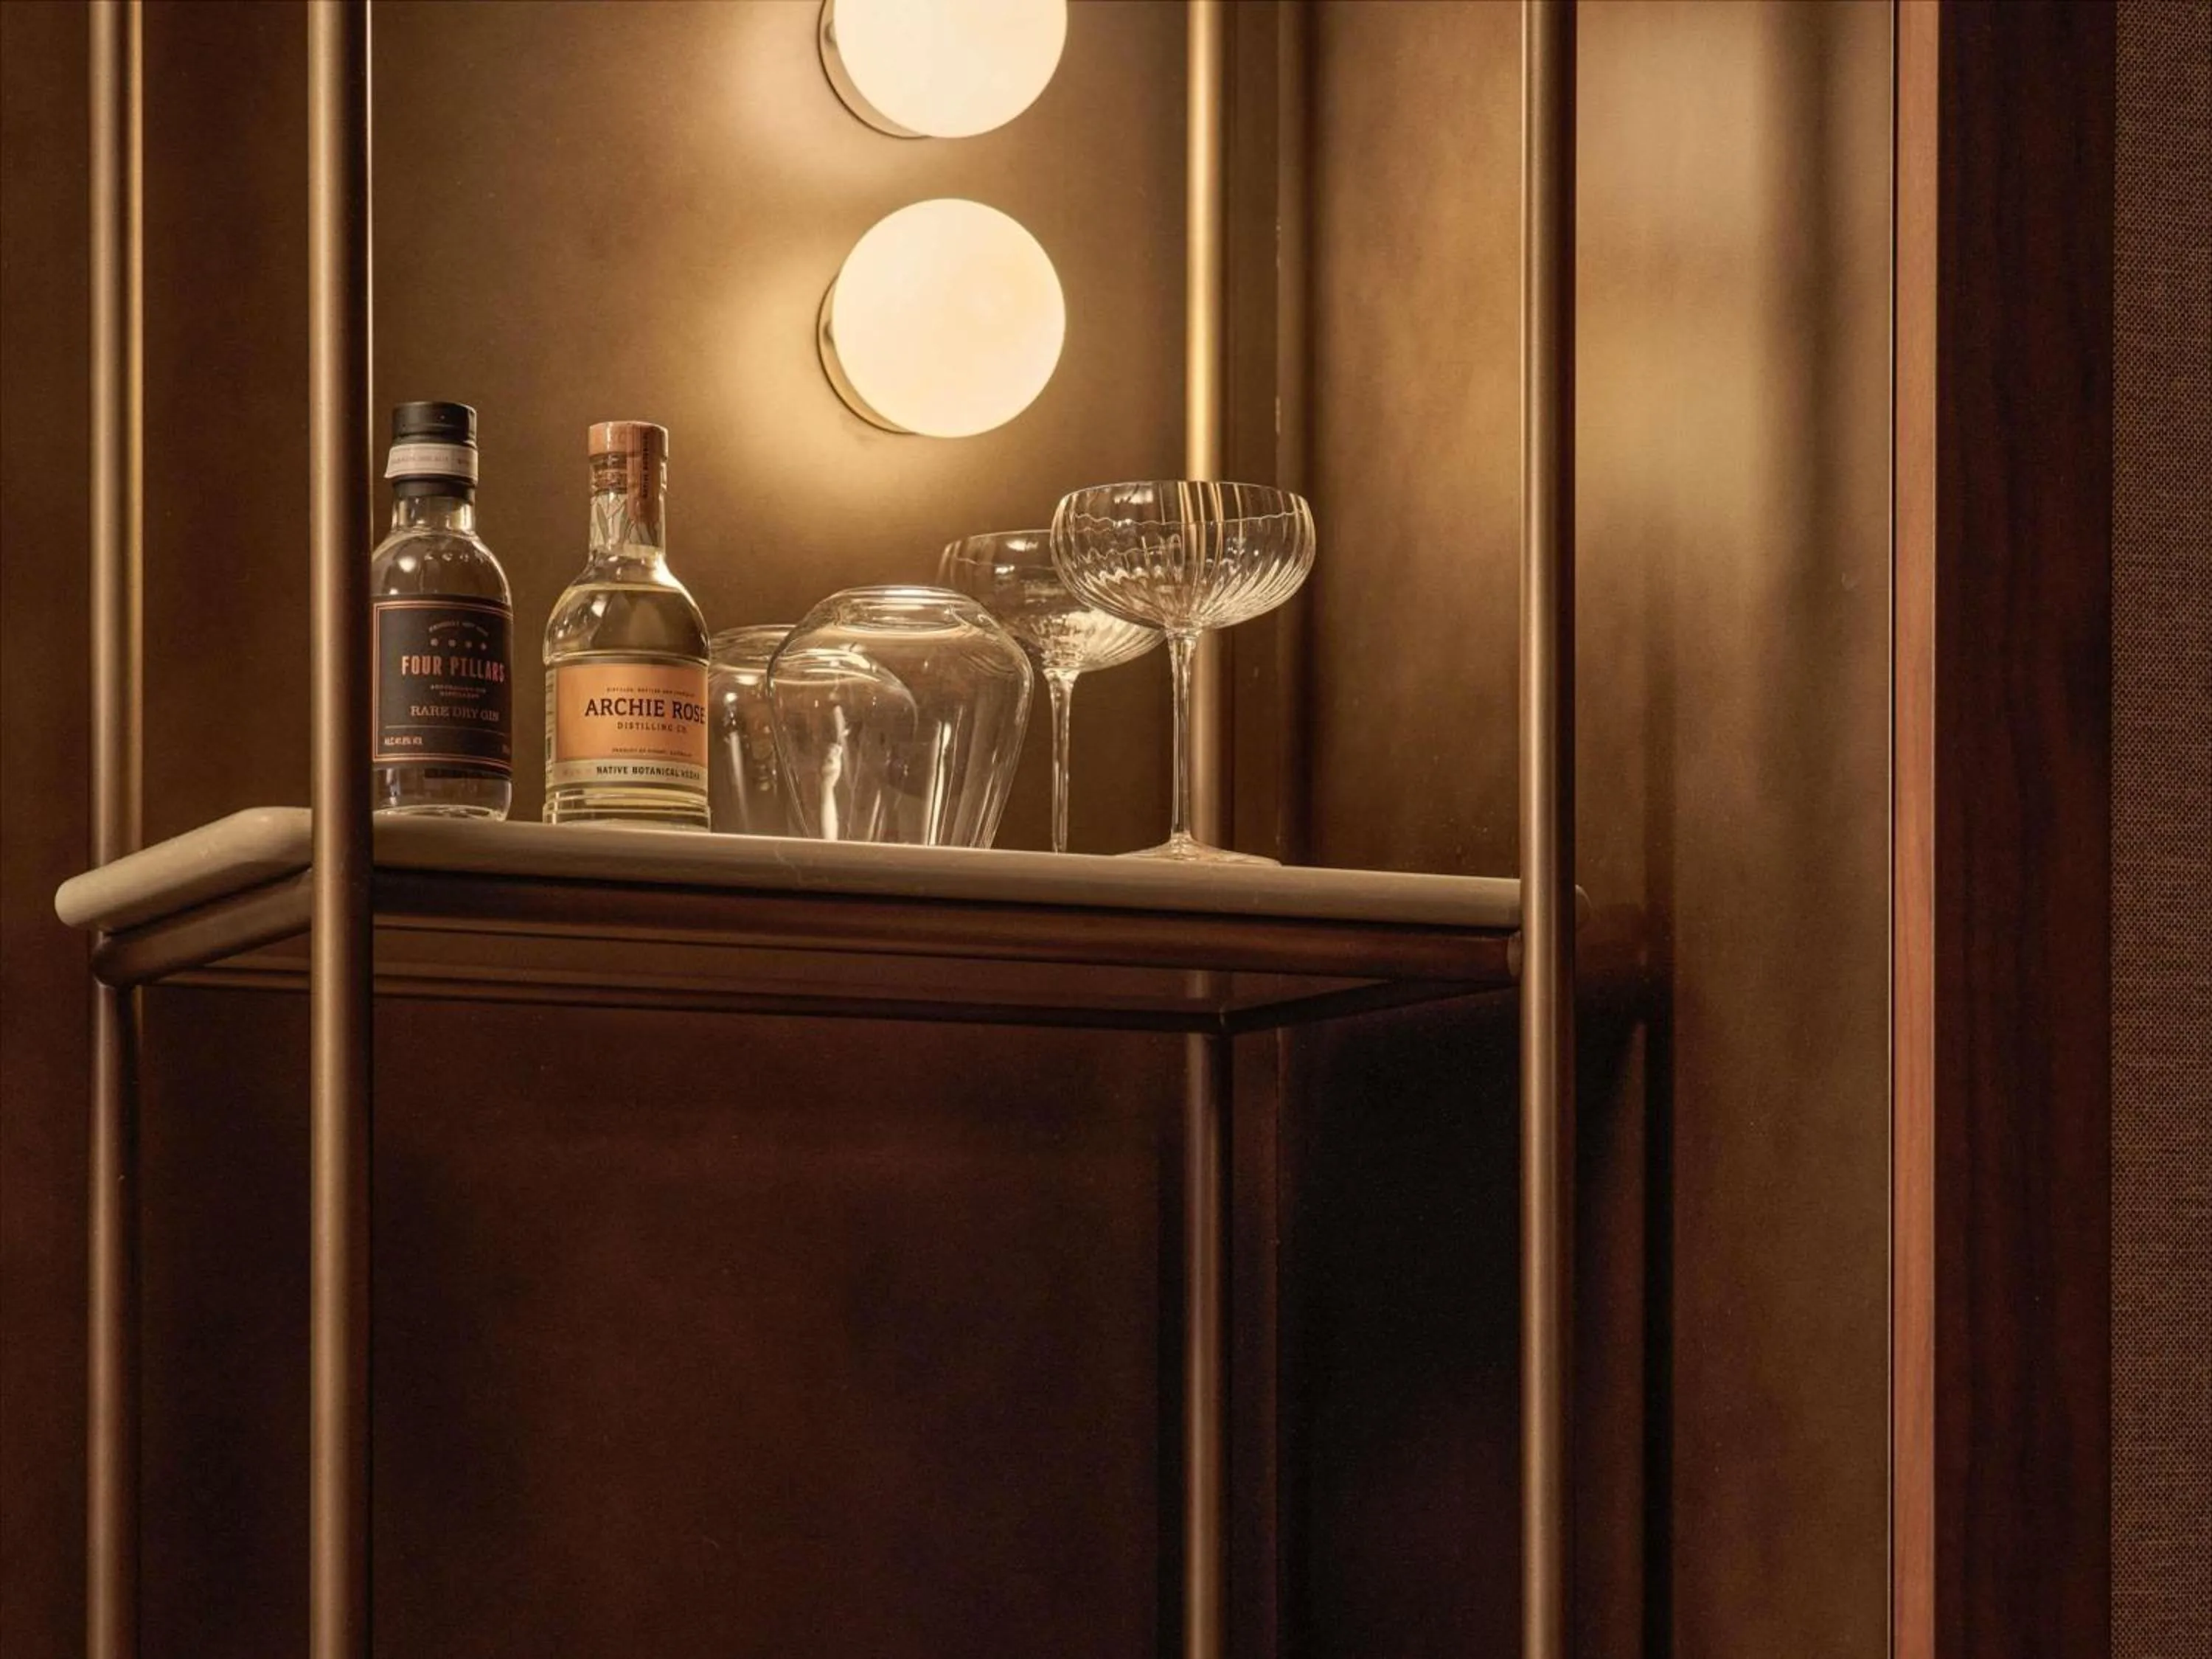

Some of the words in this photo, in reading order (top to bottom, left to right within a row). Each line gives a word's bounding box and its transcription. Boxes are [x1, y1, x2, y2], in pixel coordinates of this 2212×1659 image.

[402, 655, 442, 676] FOUR
[450, 655, 505, 683] PILLARS
[411, 706, 449, 716] RARE
[452, 707, 479, 719] DRY
[480, 710, 500, 721] GIN
[585, 698, 665, 717] ARCHIE
[672, 700, 706, 725] ROSE
[617, 722, 672, 731] DISTILLING
[596, 766, 627, 774] NATIVE
[632, 766, 679, 778] BOTANICAL
